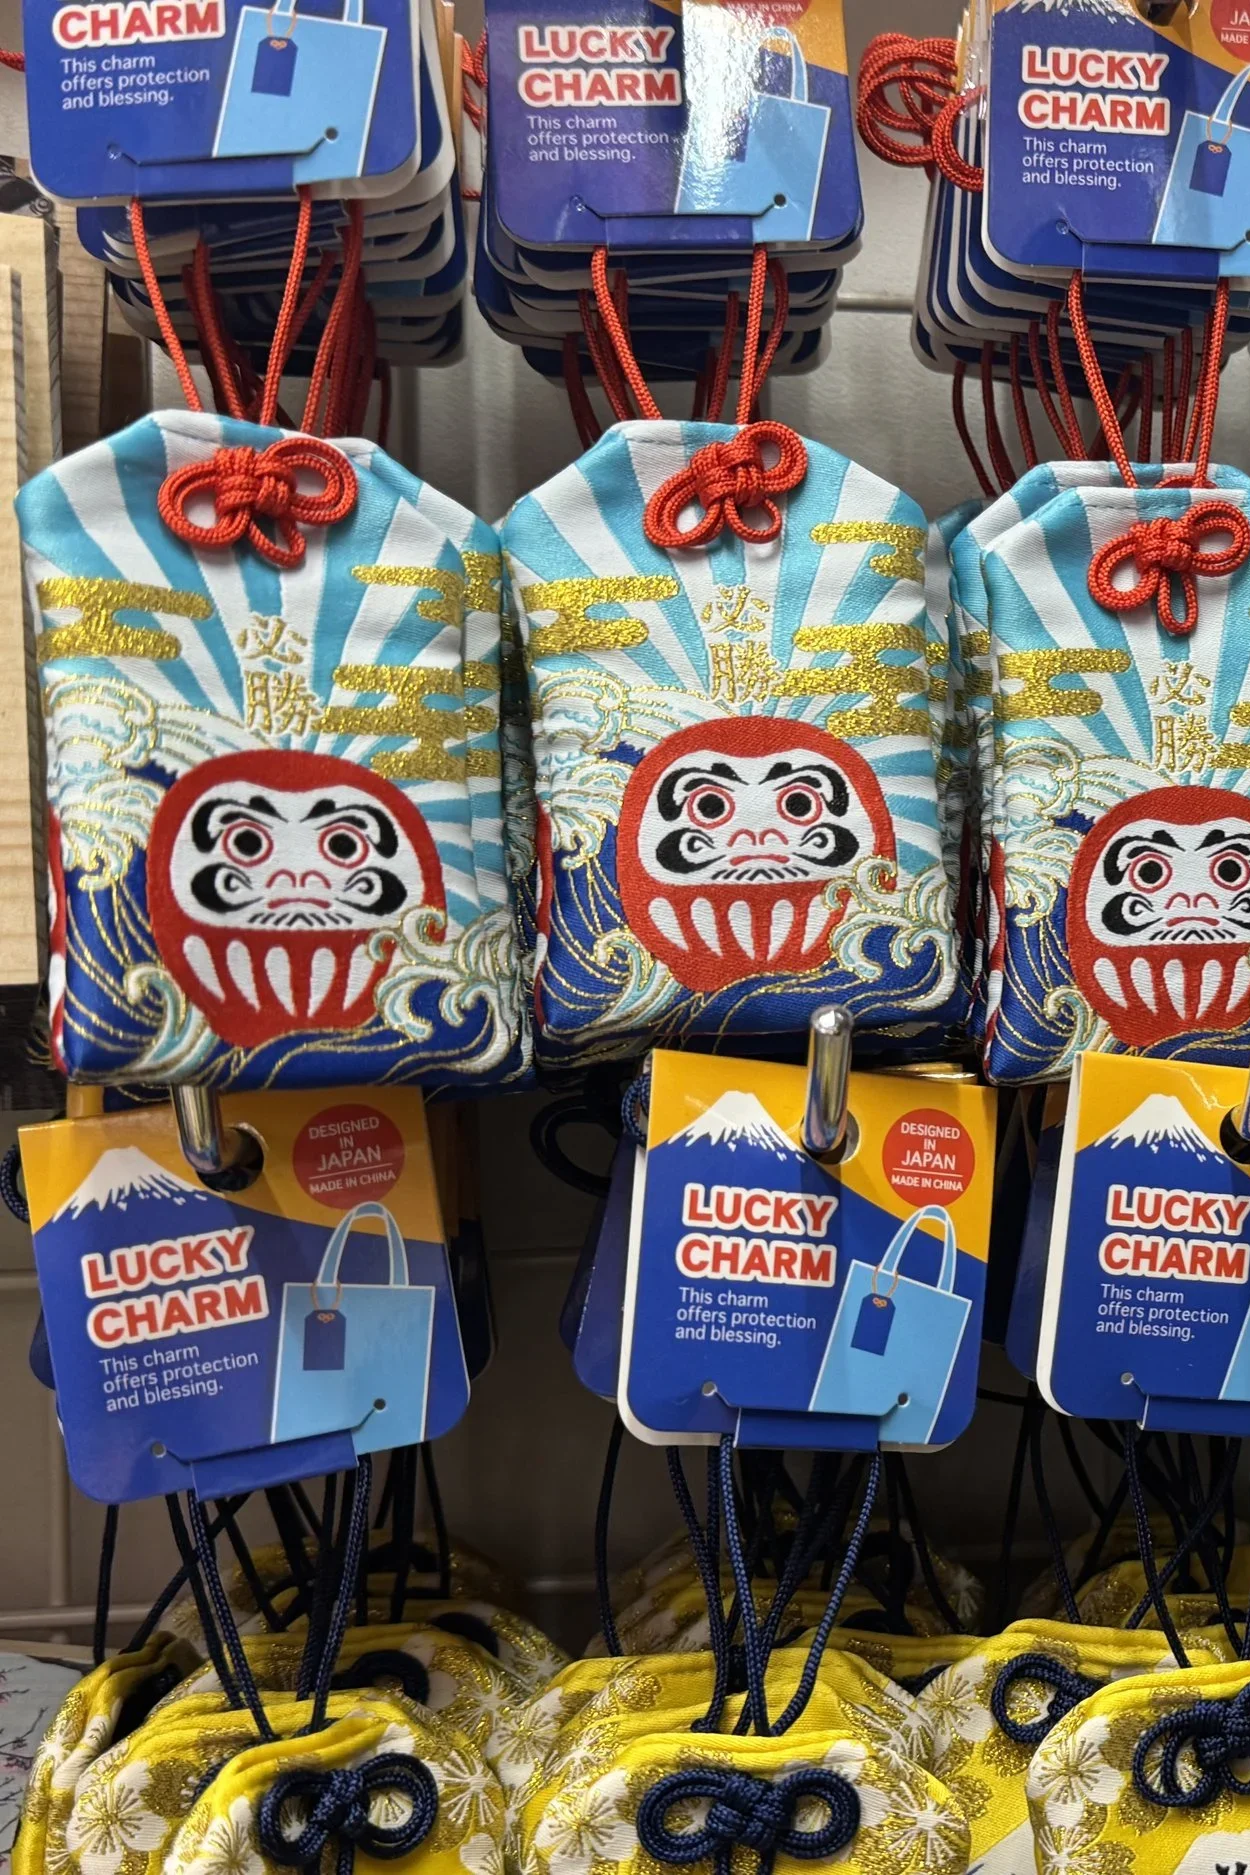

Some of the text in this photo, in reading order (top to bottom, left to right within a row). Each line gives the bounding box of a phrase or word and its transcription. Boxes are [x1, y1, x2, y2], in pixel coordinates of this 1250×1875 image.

[771, 4, 803, 13] CHINA
[59, 2, 218, 43] CHARM
[524, 29, 669, 59] LUCKY
[1220, 32, 1249, 44] MADE
[60, 55, 155, 74] This charm
[1027, 50, 1164, 86] LUCKY
[61, 67, 210, 92] offers protection
[524, 73, 676, 102] CHARM
[62, 89, 174, 110] and blessing.
[527, 115, 617, 129] This charm
[1023, 94, 1165, 131] CHARM
[528, 131, 669, 148] offers protection
[1023, 137, 1107, 155] This charm
[529, 147, 636, 163] and blessing.
[1022, 154, 1154, 174] offers protection
[1022, 170, 1122, 190] and blessing.
[701, 586, 781, 703] 必勝
[237, 614, 322, 738] 必勝
[1150, 661, 1218, 774] 必勝
[308, 1115, 380, 1140] DESIGNED
[901, 1121, 960, 1140] DESIGNED
[339, 1135, 354, 1149] IN
[924, 1139, 936, 1151] IN
[317, 1145, 382, 1172] JAPAN
[901, 1150, 956, 1171] JAPAN
[309, 1169, 396, 1194] MADE IN CHINA
[891, 1175, 963, 1192] MADE IN CHINA
[687, 1189, 835, 1231] LUCKY
[1111, 1190, 1249, 1231] LUCKY
[86, 1232, 250, 1292] LUCKY
[681, 1239, 831, 1282] CHARM
[1103, 1238, 1246, 1278] CHARM
[679, 1287, 769, 1308] This charm
[1100, 1283, 1184, 1304] This charm
[93, 1280, 263, 1343] CHARM
[676, 1306, 817, 1330] offers protection
[1098, 1303, 1229, 1324] offers protection
[675, 1325, 782, 1348] and blessing.
[1096, 1320, 1195, 1341] and blessing.
[99, 1346, 199, 1376] This charm
[103, 1352, 259, 1394] offers protection
[106, 1379, 223, 1412] and blessing.
